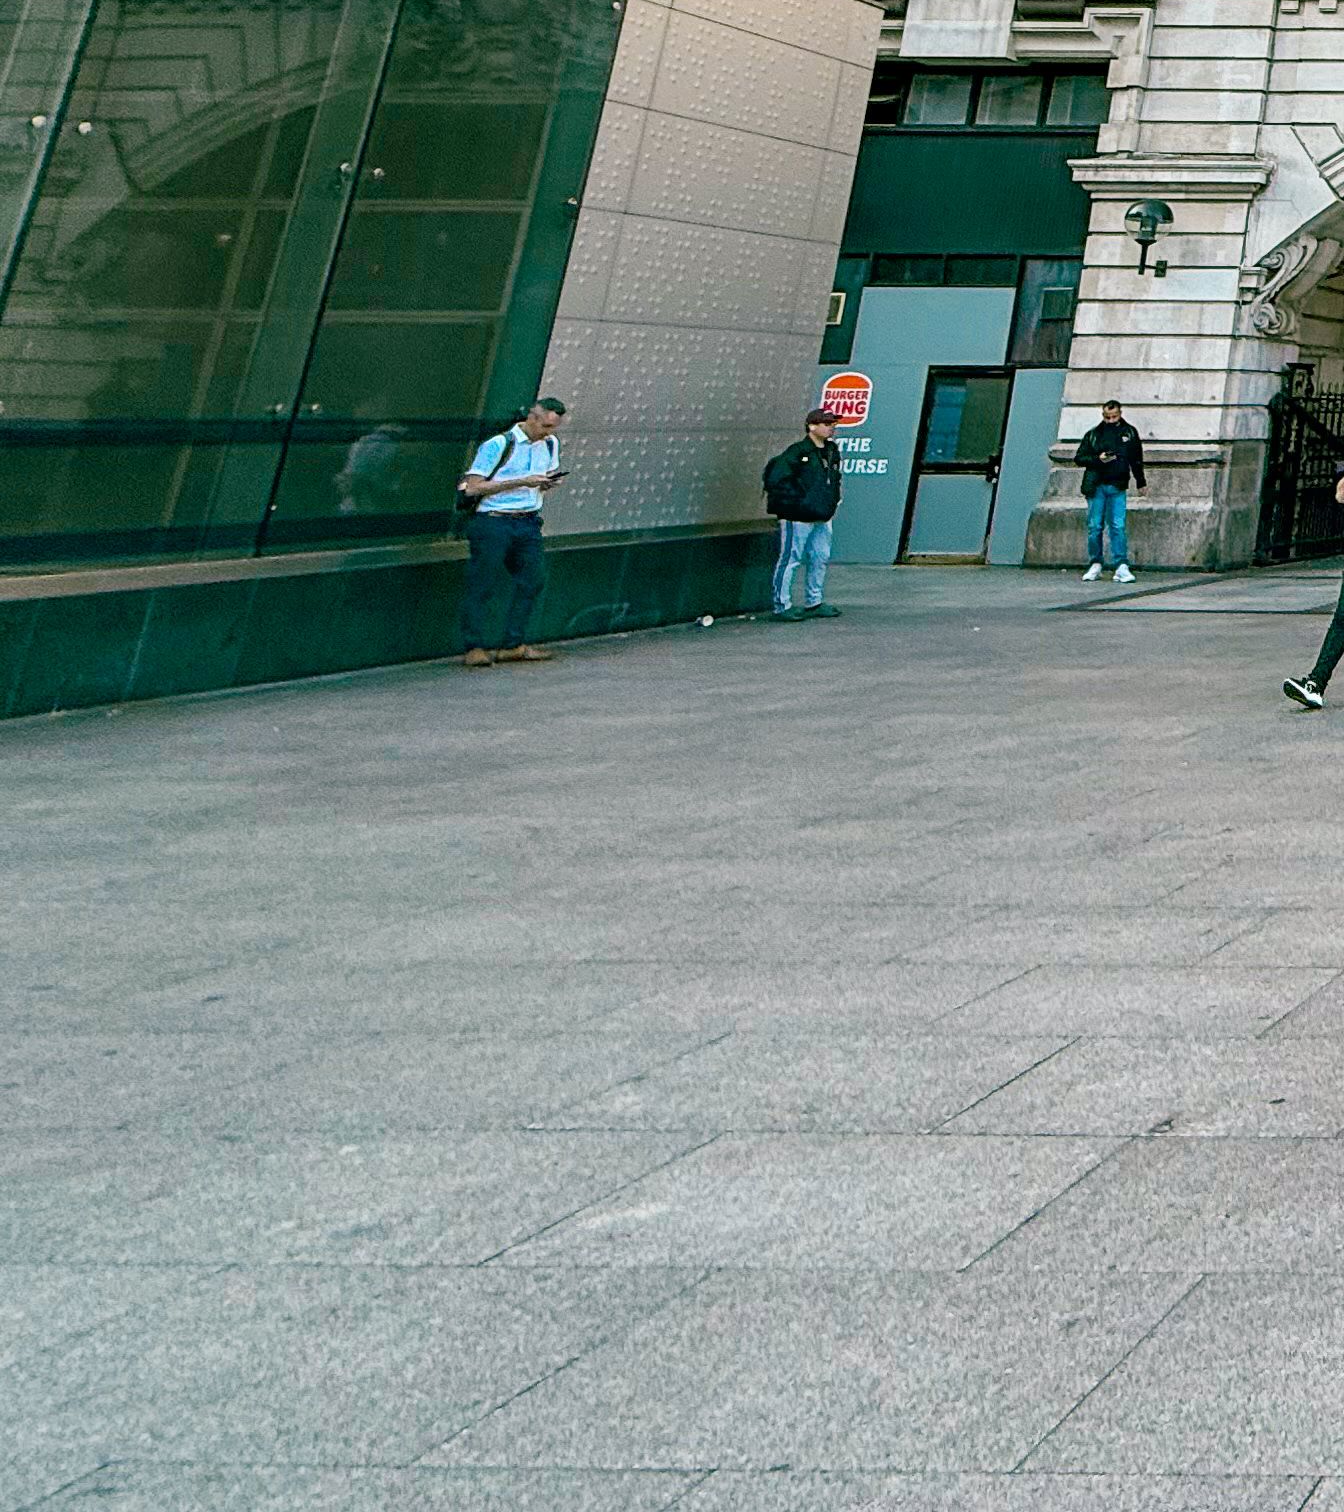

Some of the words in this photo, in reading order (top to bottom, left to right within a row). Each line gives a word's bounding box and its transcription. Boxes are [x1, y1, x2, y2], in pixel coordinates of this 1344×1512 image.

[824, 390, 869, 400] BURGER
[823, 400, 867, 415] KING
[835, 437, 873, 452] THE
[839, 458, 889, 474] URSE
